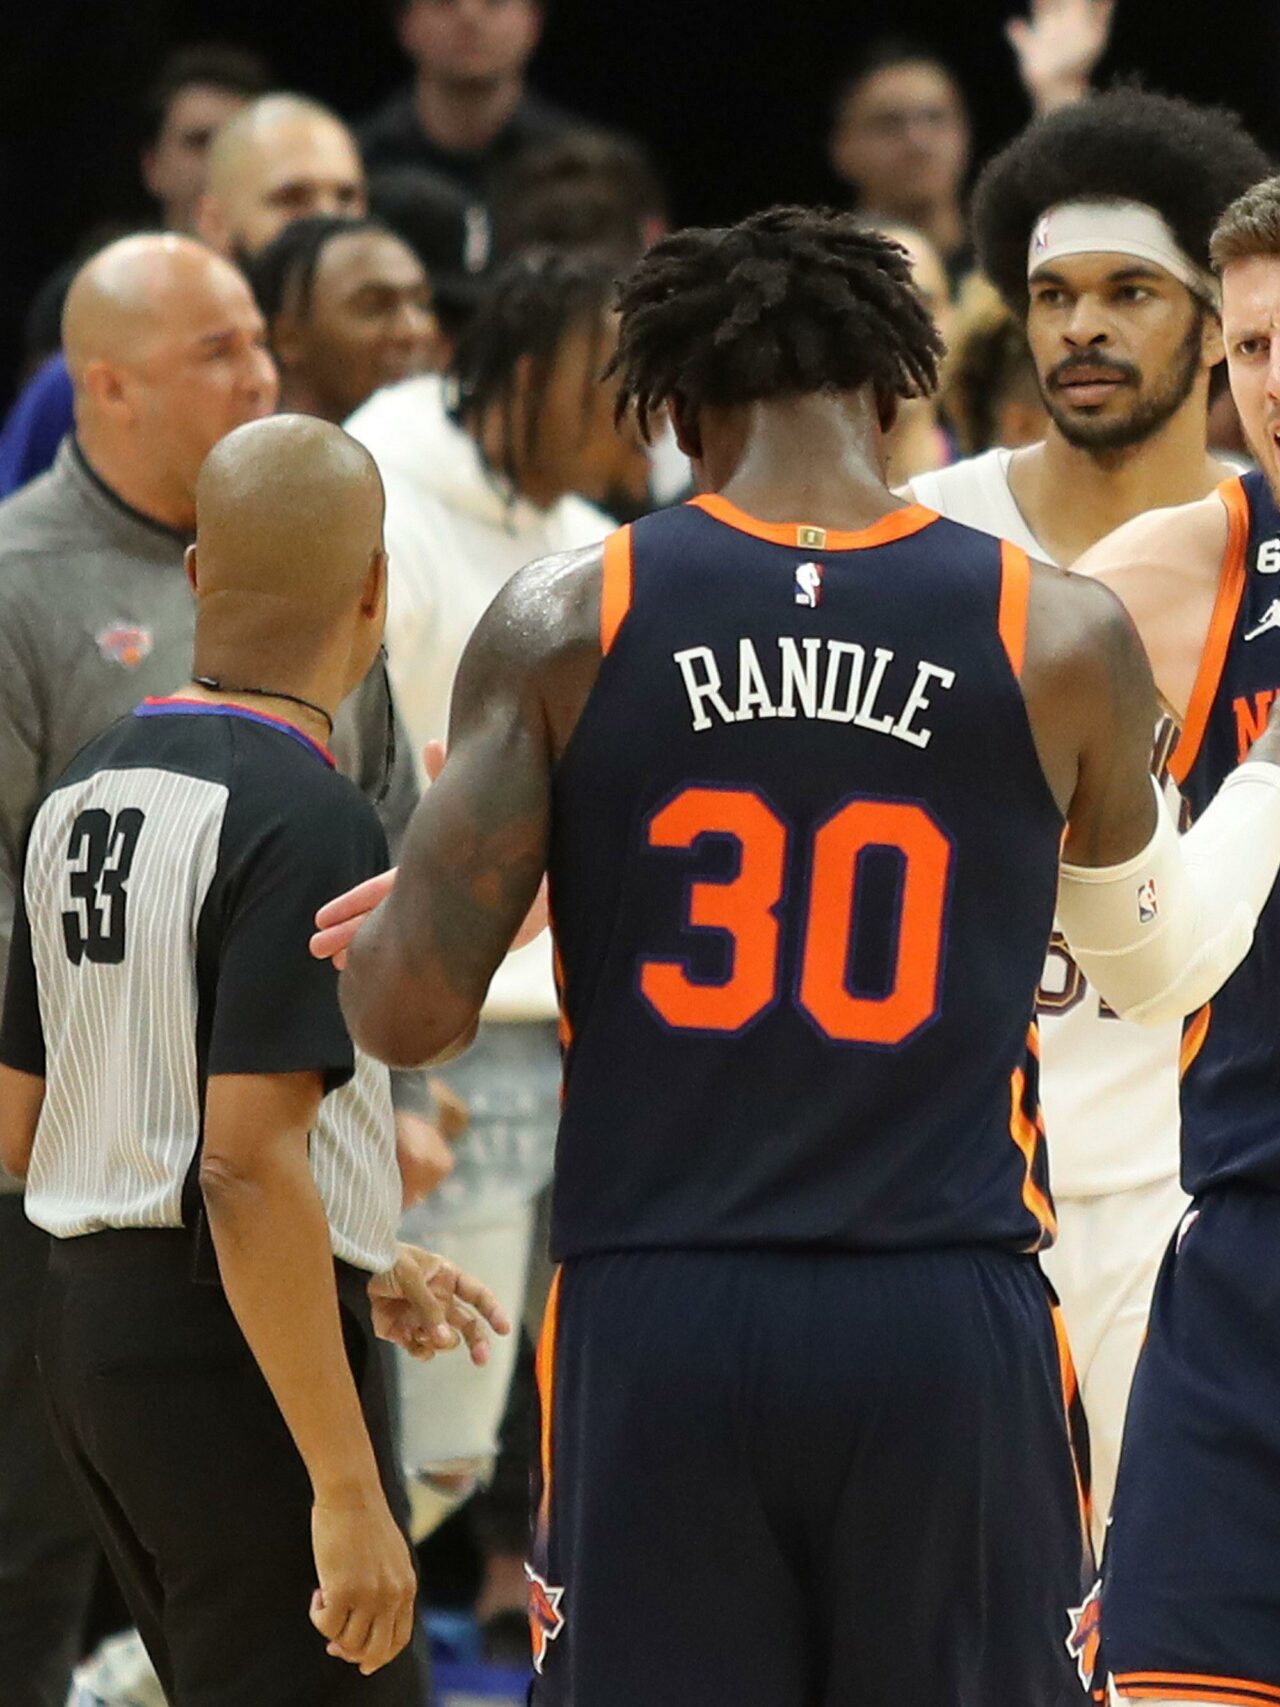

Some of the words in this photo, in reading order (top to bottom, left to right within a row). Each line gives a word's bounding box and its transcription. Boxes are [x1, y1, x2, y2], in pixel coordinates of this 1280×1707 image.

[673, 637, 956, 749] RANDLE
[61, 807, 146, 967] 33
[640, 786, 952, 1045] 30
